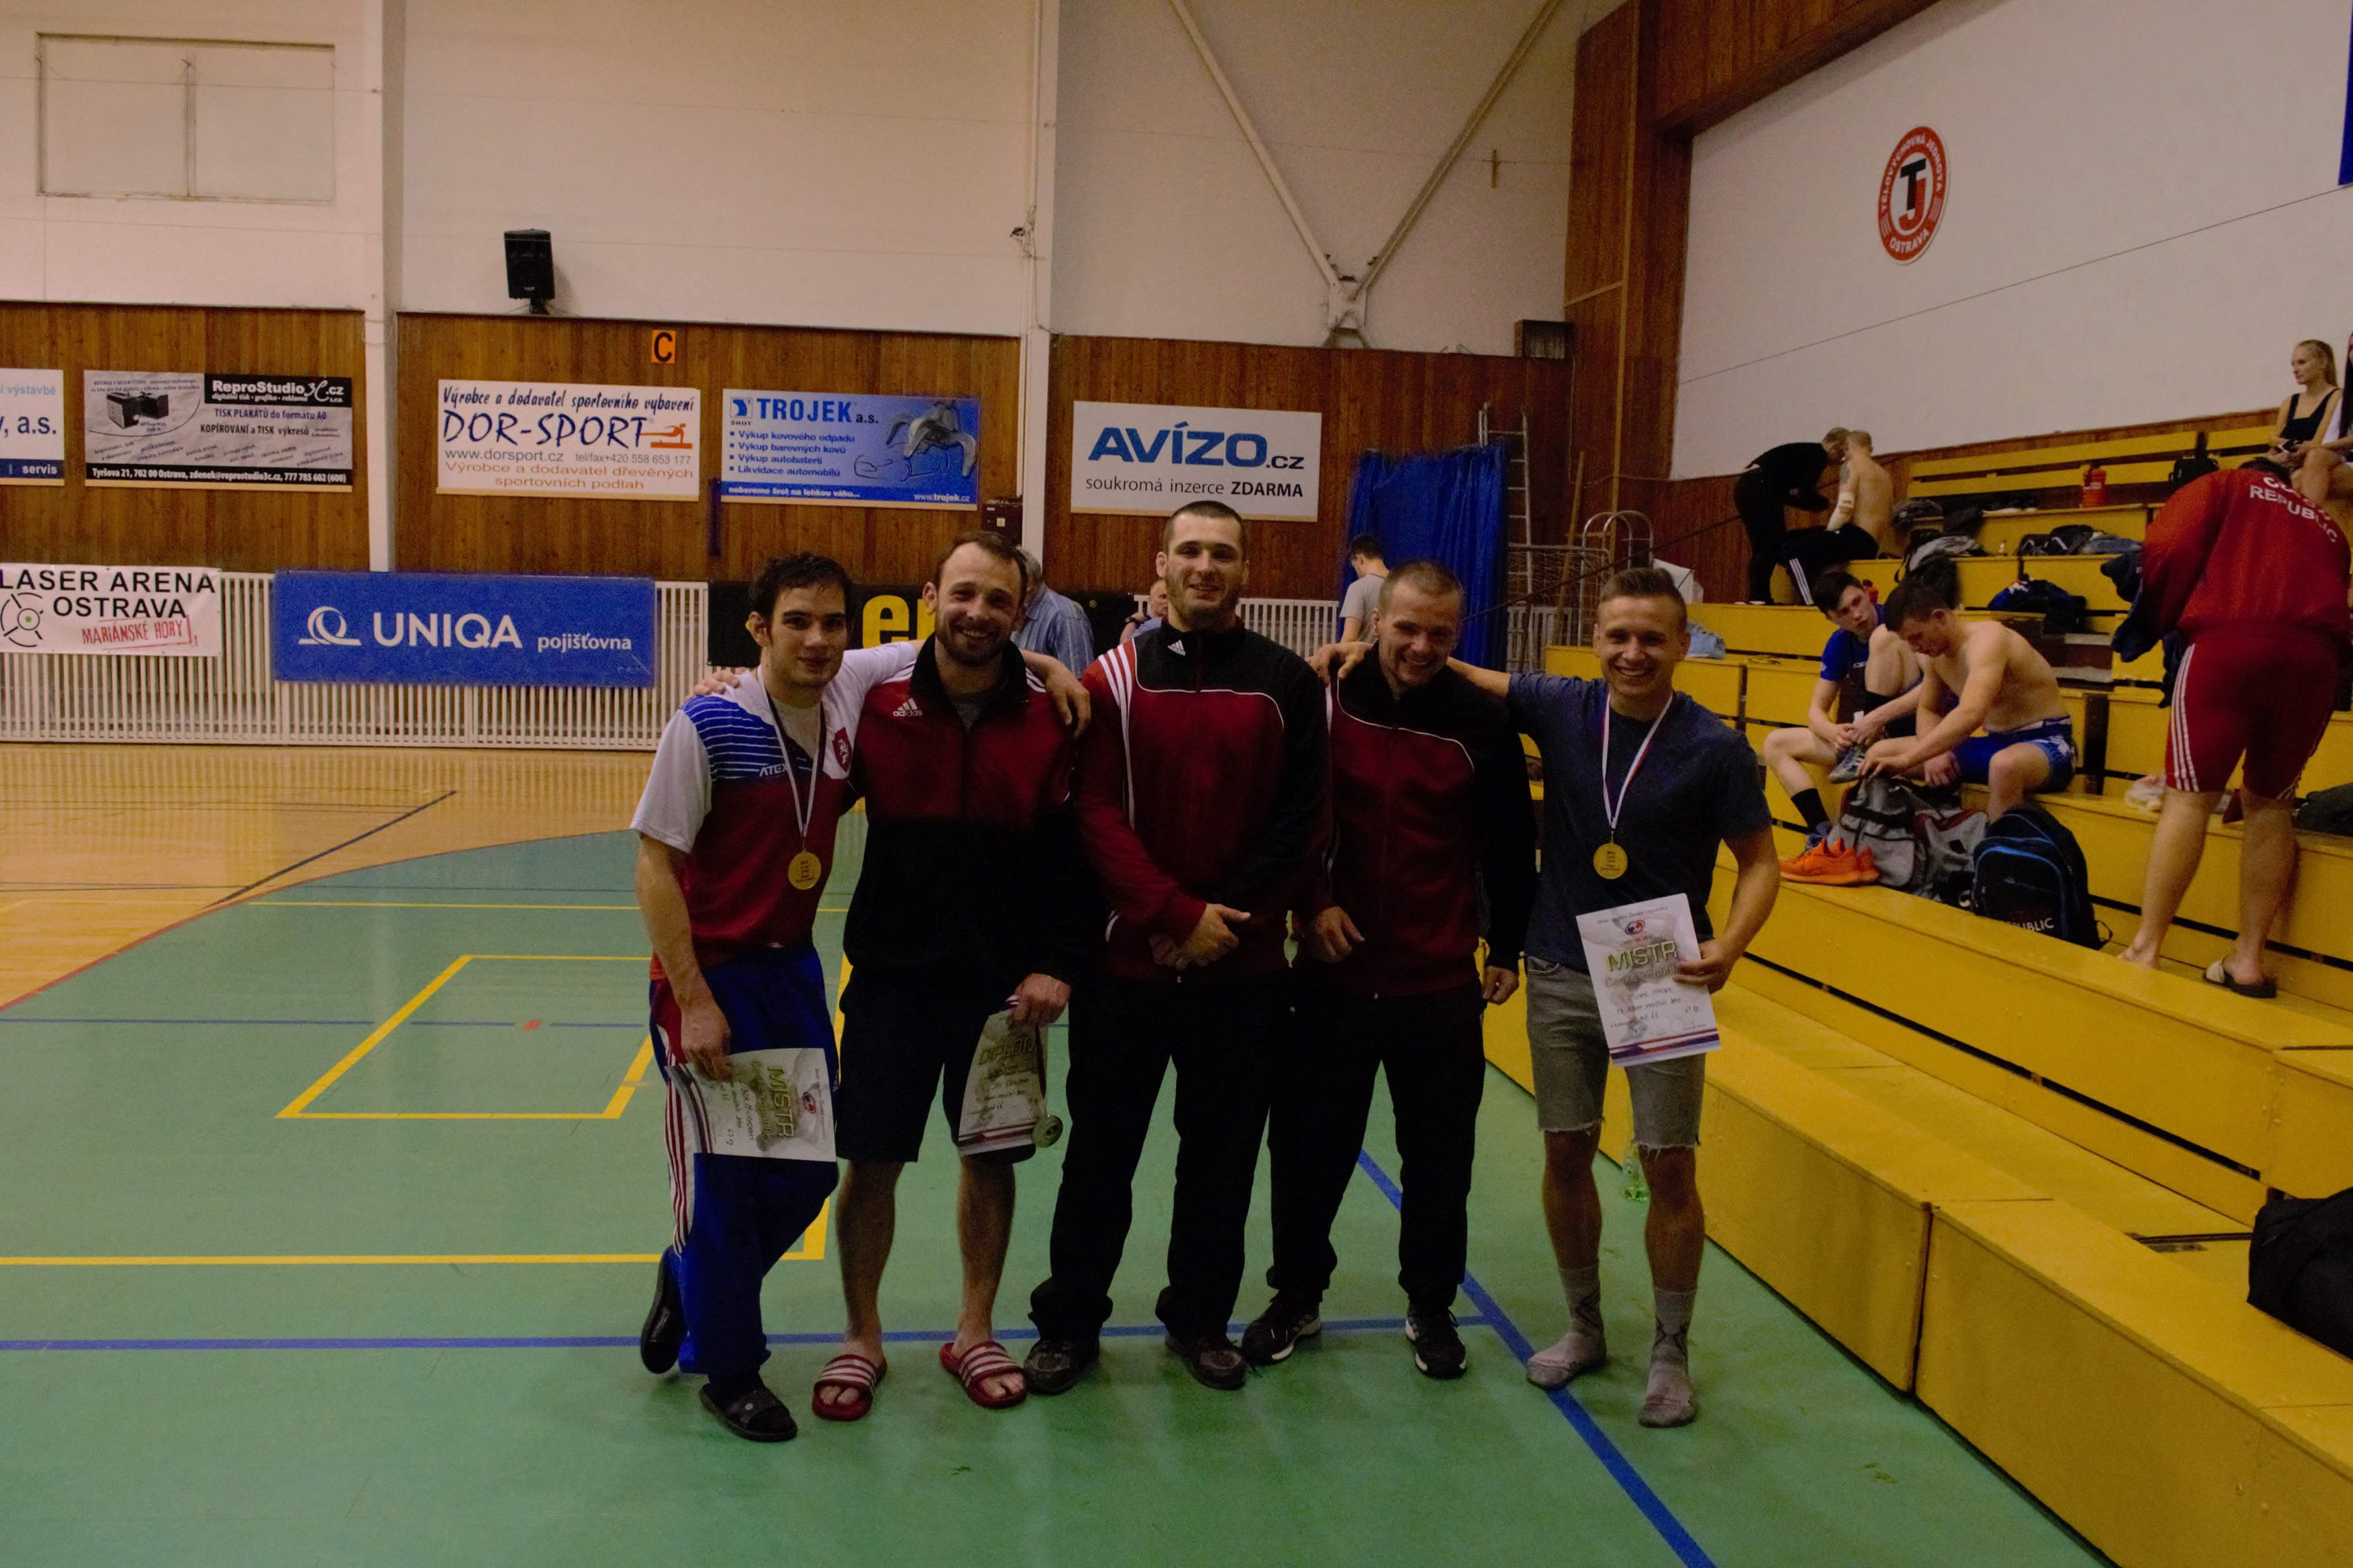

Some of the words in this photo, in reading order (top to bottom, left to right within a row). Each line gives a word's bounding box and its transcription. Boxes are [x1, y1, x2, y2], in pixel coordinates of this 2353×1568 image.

[1890, 228, 1930, 253] OSTRAVA
[654, 333, 672, 362] C
[7, 385, 56, 396] výstavbě
[443, 386, 489, 408] Výrobce
[496, 395, 502, 404] a
[508, 388, 566, 406] dodavatel
[572, 392, 638, 413] sportovního
[645, 393, 694, 415] vybavení
[215, 409, 231, 418] TISK
[234, 408, 268, 418] PLAKÁTŮ
[270, 411, 280, 419] do
[282, 410, 315, 420] formátu
[757, 398, 852, 423] TROJEK
[856, 414, 878, 423] a.s.
[17, 416, 56, 435] a.s.
[200, 423, 248, 434] KOPÍROVÁNÍ
[258, 426, 274, 435] TISK
[278, 426, 309, 437] výkresů
[443, 410, 647, 449] DOR-SPORT
[739, 431, 768, 440] Výkup
[772, 432, 816, 441] kovového
[819, 434, 855, 443] odpadu
[445, 449, 564, 463] www.dorsport.cz
[632, 454, 649, 464] 558
[653, 454, 670, 464] 653
[674, 455, 691, 464] 177
[739, 442, 768, 451] Výkup
[771, 443, 820, 453] barevných
[823, 445, 846, 454] kovů
[738, 454, 768, 463] Výkup
[22, 465, 57, 474] servis
[92, 468, 119, 478] Tyršova
[121, 469, 132, 478] 21,
[134, 469, 147, 477] 702
[148, 469, 157, 477] 00
[158, 469, 188, 480] Ostrava,
[284, 473, 297, 481] 777
[299, 473, 312, 481] 785
[446, 461, 510, 474] Výrobce
[531, 465, 607, 476] dodavatel
[612, 467, 693, 479] dřevěných
[738, 466, 784, 474] Likvidace
[787, 468, 840, 477] automobilů
[495, 478, 586, 487] sportovních
[592, 479, 644, 489] podlah
[804, 488, 831, 496] lehkou
[1086, 476, 1163, 492] soukromá
[1170, 478, 1224, 495] inzerce
[1231, 481, 1303, 497] ZDARMA
[913, 493, 970, 503] www.trojek.cz
[2250, 484, 2338, 543] REPUBLIC
[0, 569, 99, 592] LASER
[110, 571, 215, 593] ARENA
[53, 596, 187, 619] OSTRAVA
[82, 619, 148, 644] MARIÁNSKÉ
[155, 620, 183, 638] HORY
[373, 612, 523, 648] UNIQA
[537, 632, 632, 654] pojišťovna
[893, 709, 923, 717] adidas
[1608, 940, 1679, 972] MISTR
[767, 1067, 795, 1137] MISTR
